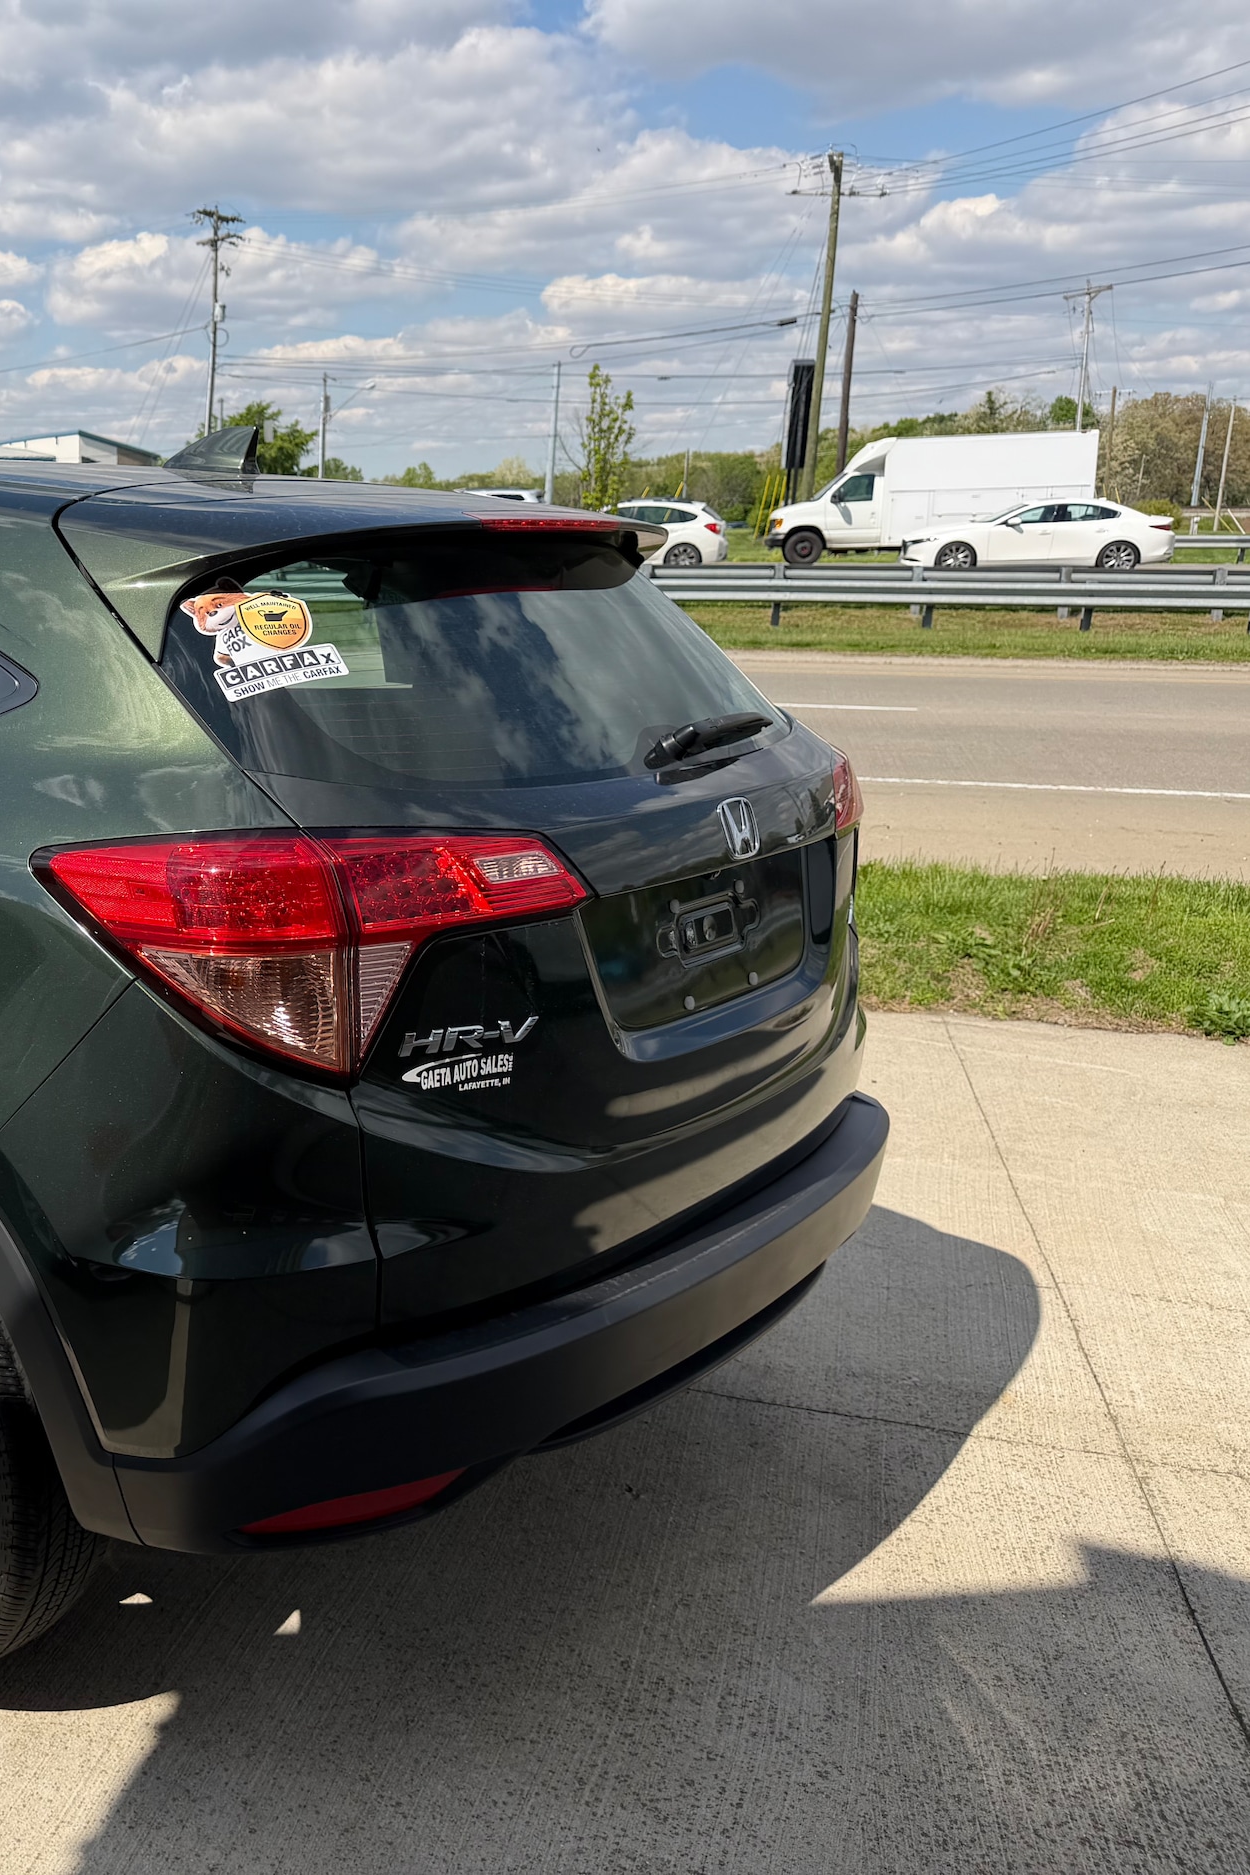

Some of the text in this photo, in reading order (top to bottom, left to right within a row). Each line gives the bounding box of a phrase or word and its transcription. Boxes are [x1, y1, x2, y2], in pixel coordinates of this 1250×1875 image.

[244, 601, 297, 611] WELL MAINTAINED
[222, 625, 245, 644] CAR
[226, 636, 252, 657] FOX
[222, 650, 336, 688] CARFAX
[233, 665, 342, 698] SHOW ME THE CARFAX
[398, 1016, 540, 1057] HR-V
[420, 1067, 451, 1090] GAETA
[453, 1058, 479, 1084] AUTO
[479, 1053, 509, 1076] SALES
[458, 1076, 511, 1092] LAFAYETTE, IN
